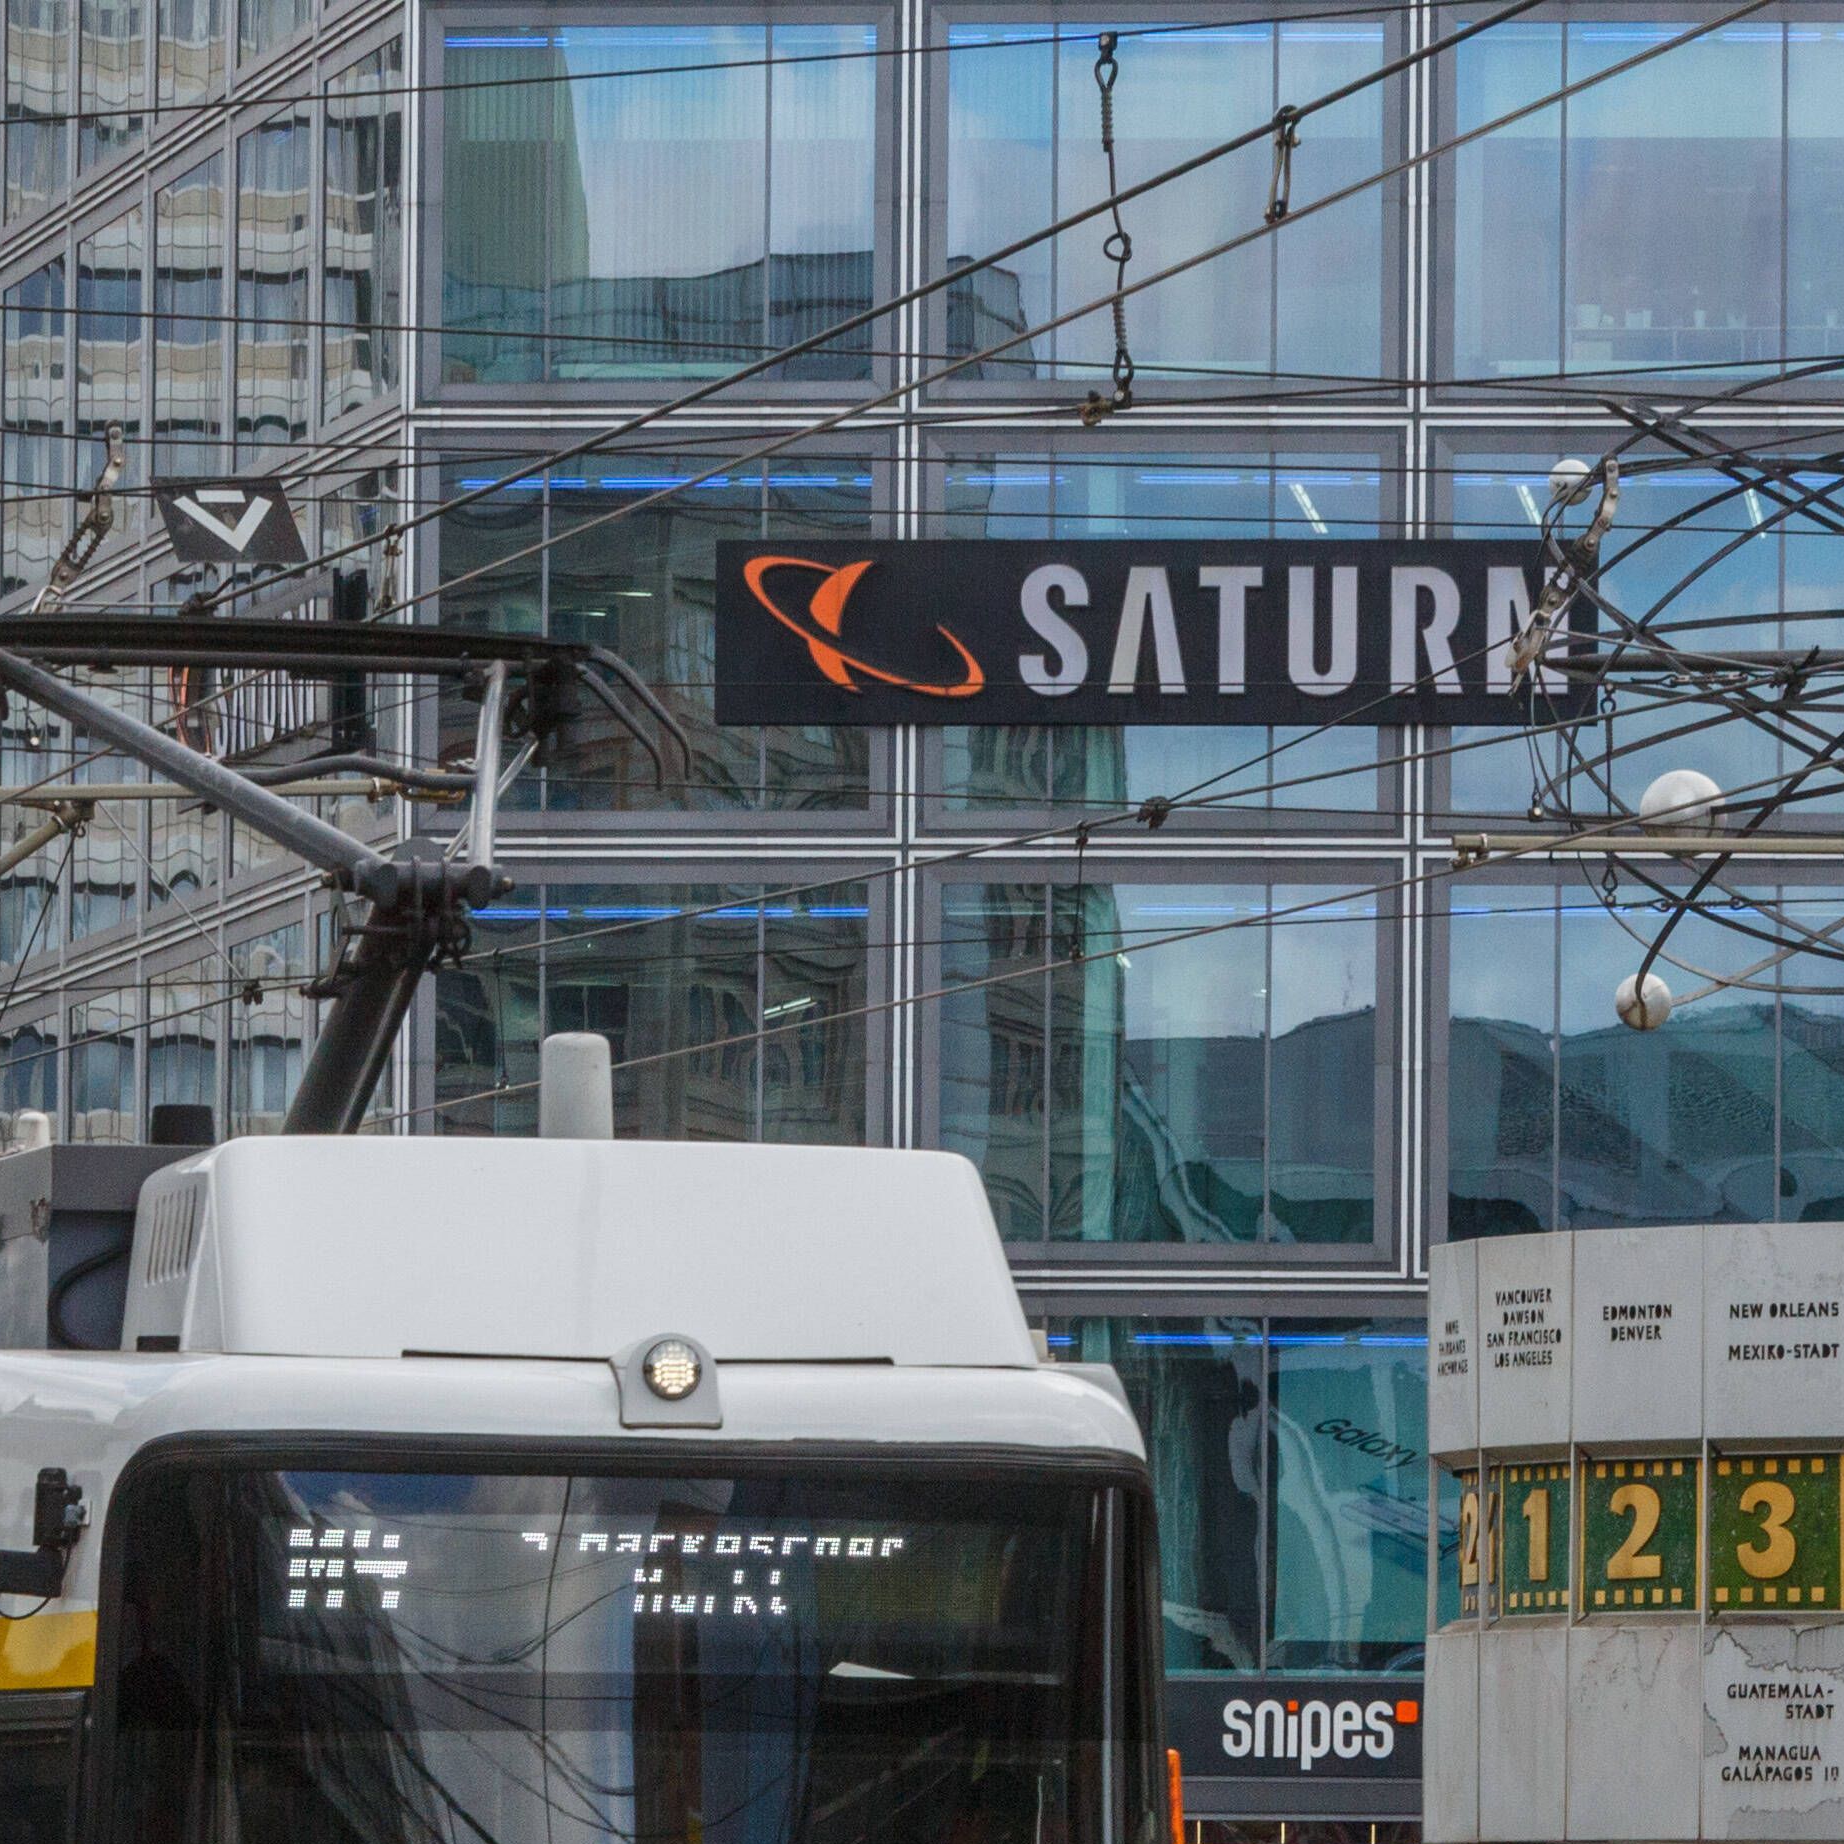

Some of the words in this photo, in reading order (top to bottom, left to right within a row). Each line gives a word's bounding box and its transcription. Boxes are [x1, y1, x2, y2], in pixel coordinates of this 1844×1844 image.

[1019, 563, 1569, 695] SATURN
[1496, 1288, 1552, 1306] VANCOUVER
[1503, 1309, 1544, 1326] DAWSON
[1603, 1304, 1672, 1321] EDMONTON
[1730, 1304, 1763, 1319] NEW
[1769, 1302, 1839, 1318] ORLEANS
[1487, 1332, 1504, 1348] SAN
[1508, 1328, 1561, 1346] FRANCISCO
[1611, 1325, 1662, 1342] DENVER
[1495, 1353, 1510, 1368] LOS
[1513, 1350, 1552, 1367] ANGELES
[1728, 1343, 1840, 1361] MEXIKO-STADT
[1314, 1418, 1417, 1470] Galaxy
[1523, 1488, 1548, 1581] 1
[1607, 1484, 1661, 1580] 2
[1737, 1481, 1796, 1578] 3
[1727, 1683, 1833, 1701] GUATEMALA-
[1786, 1702, 1834, 1720] STADT
[1222, 1700, 1394, 1769] snipes
[1739, 1745, 1821, 1764] MANAGUA
[1722, 1761, 1812, 1782] GALÁPAGOS
